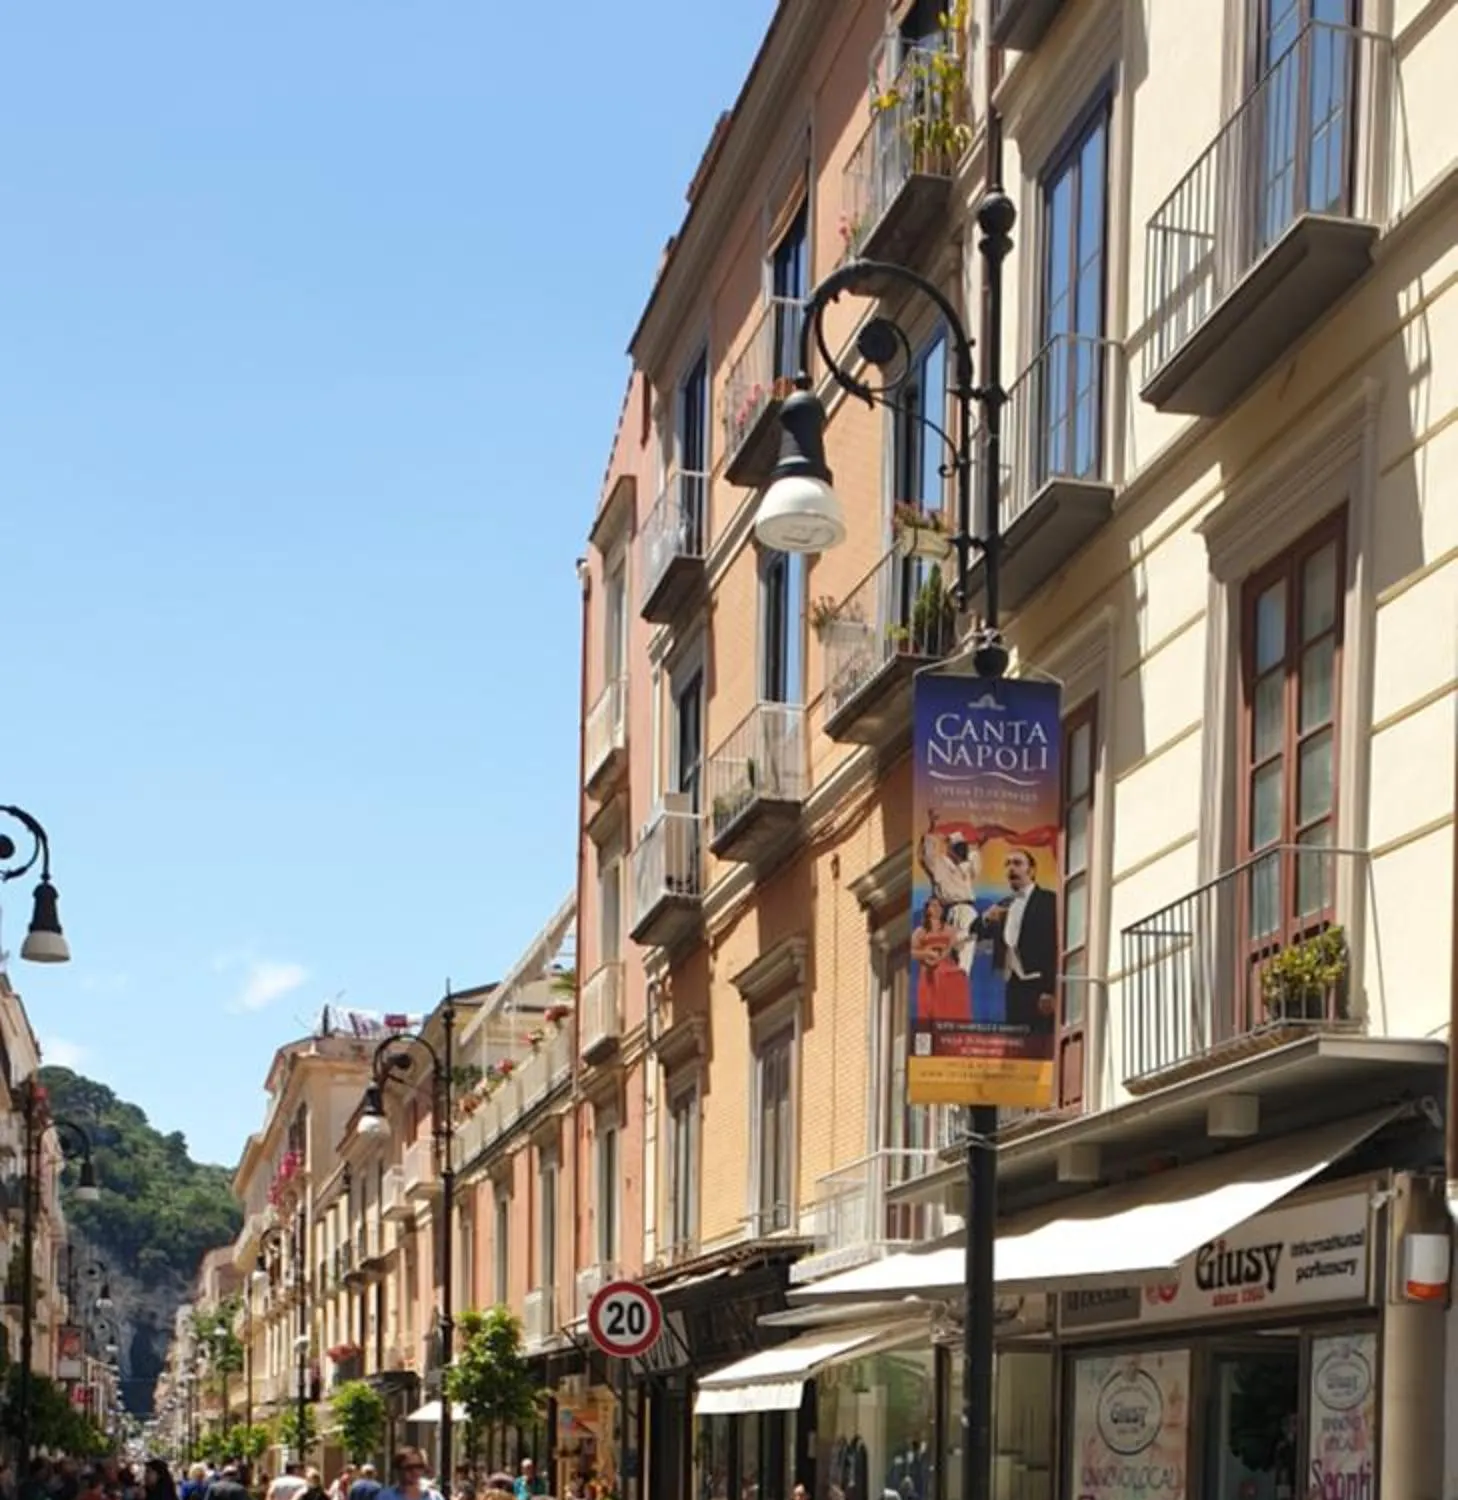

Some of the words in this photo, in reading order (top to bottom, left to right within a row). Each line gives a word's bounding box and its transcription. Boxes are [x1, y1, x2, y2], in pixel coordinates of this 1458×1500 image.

[935, 712, 1048, 745] CANTA
[927, 738, 1048, 772] NAPOLI
[1290, 1228, 1366, 1258] international
[1195, 1238, 1283, 1293] Giusy
[1295, 1258, 1359, 1284] perfumery
[606, 1301, 646, 1335] 20
